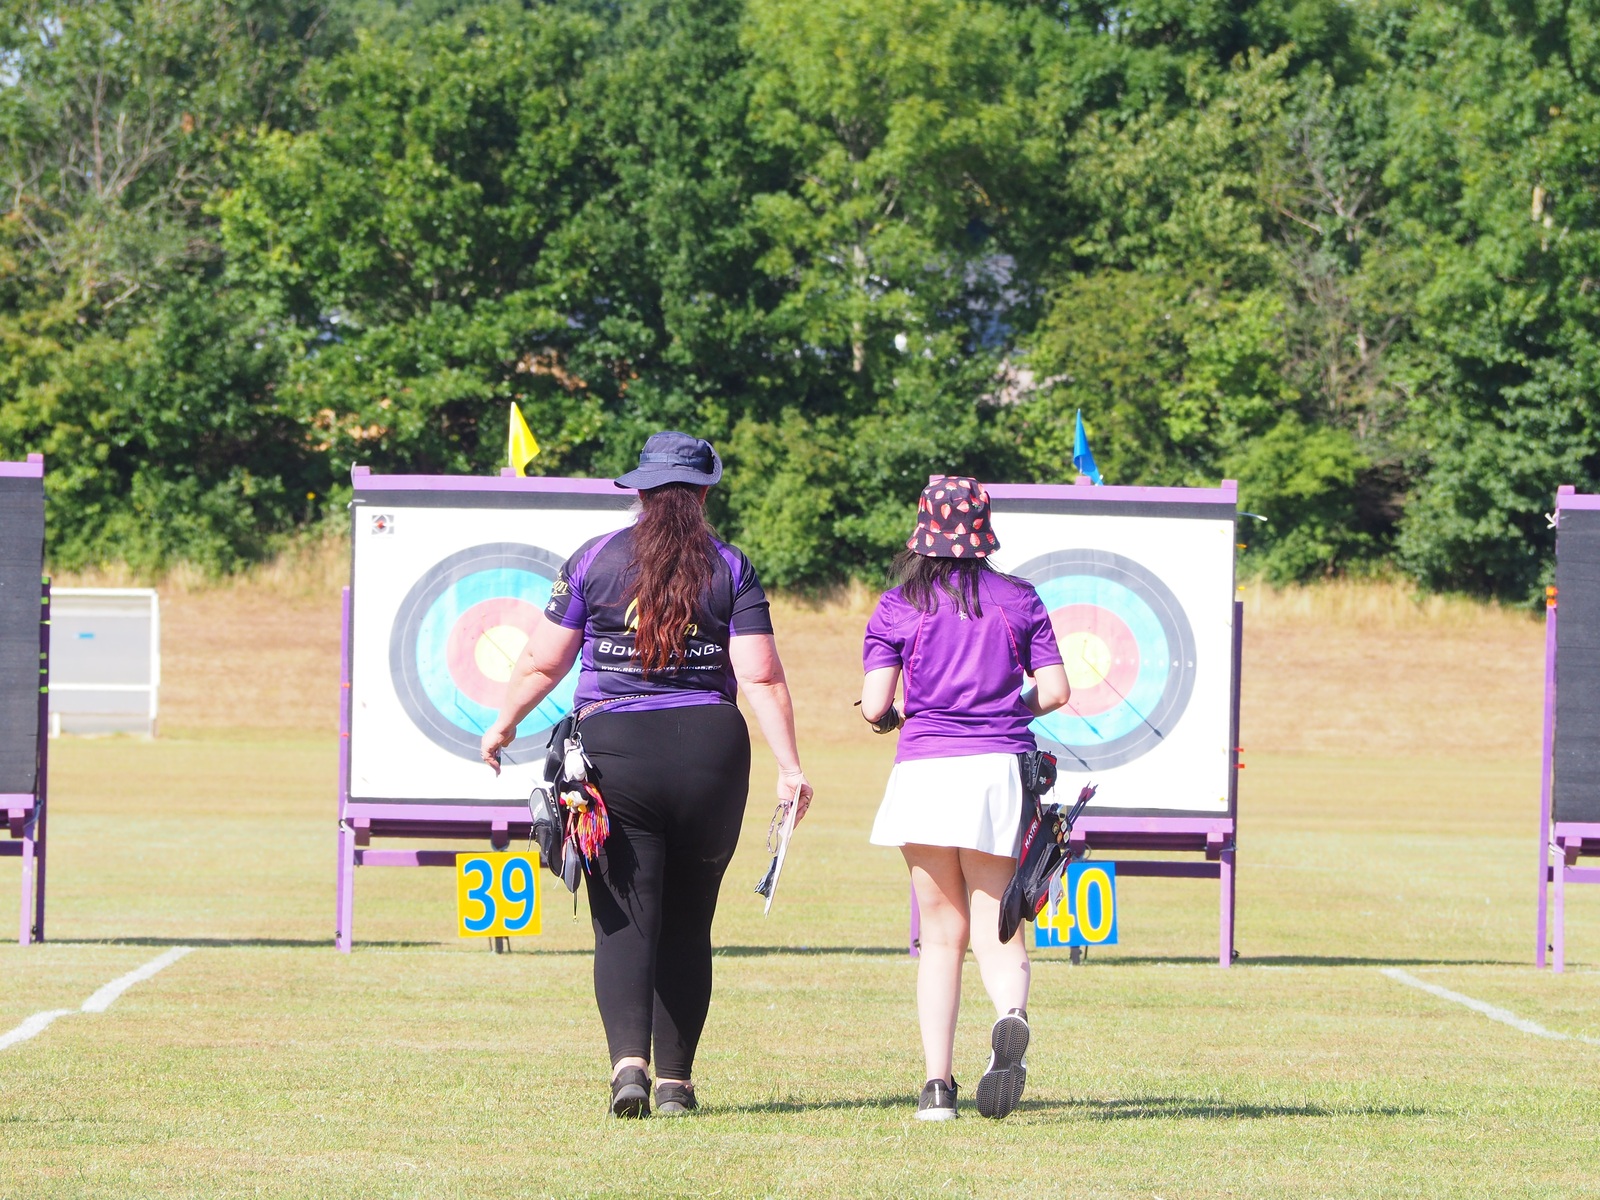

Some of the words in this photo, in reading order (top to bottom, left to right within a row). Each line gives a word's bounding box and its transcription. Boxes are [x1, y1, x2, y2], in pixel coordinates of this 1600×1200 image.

[598, 640, 722, 658] BOWRINGS
[1025, 818, 1039, 849] MATRI
[464, 857, 535, 932] 39
[1036, 867, 1113, 943] 40
